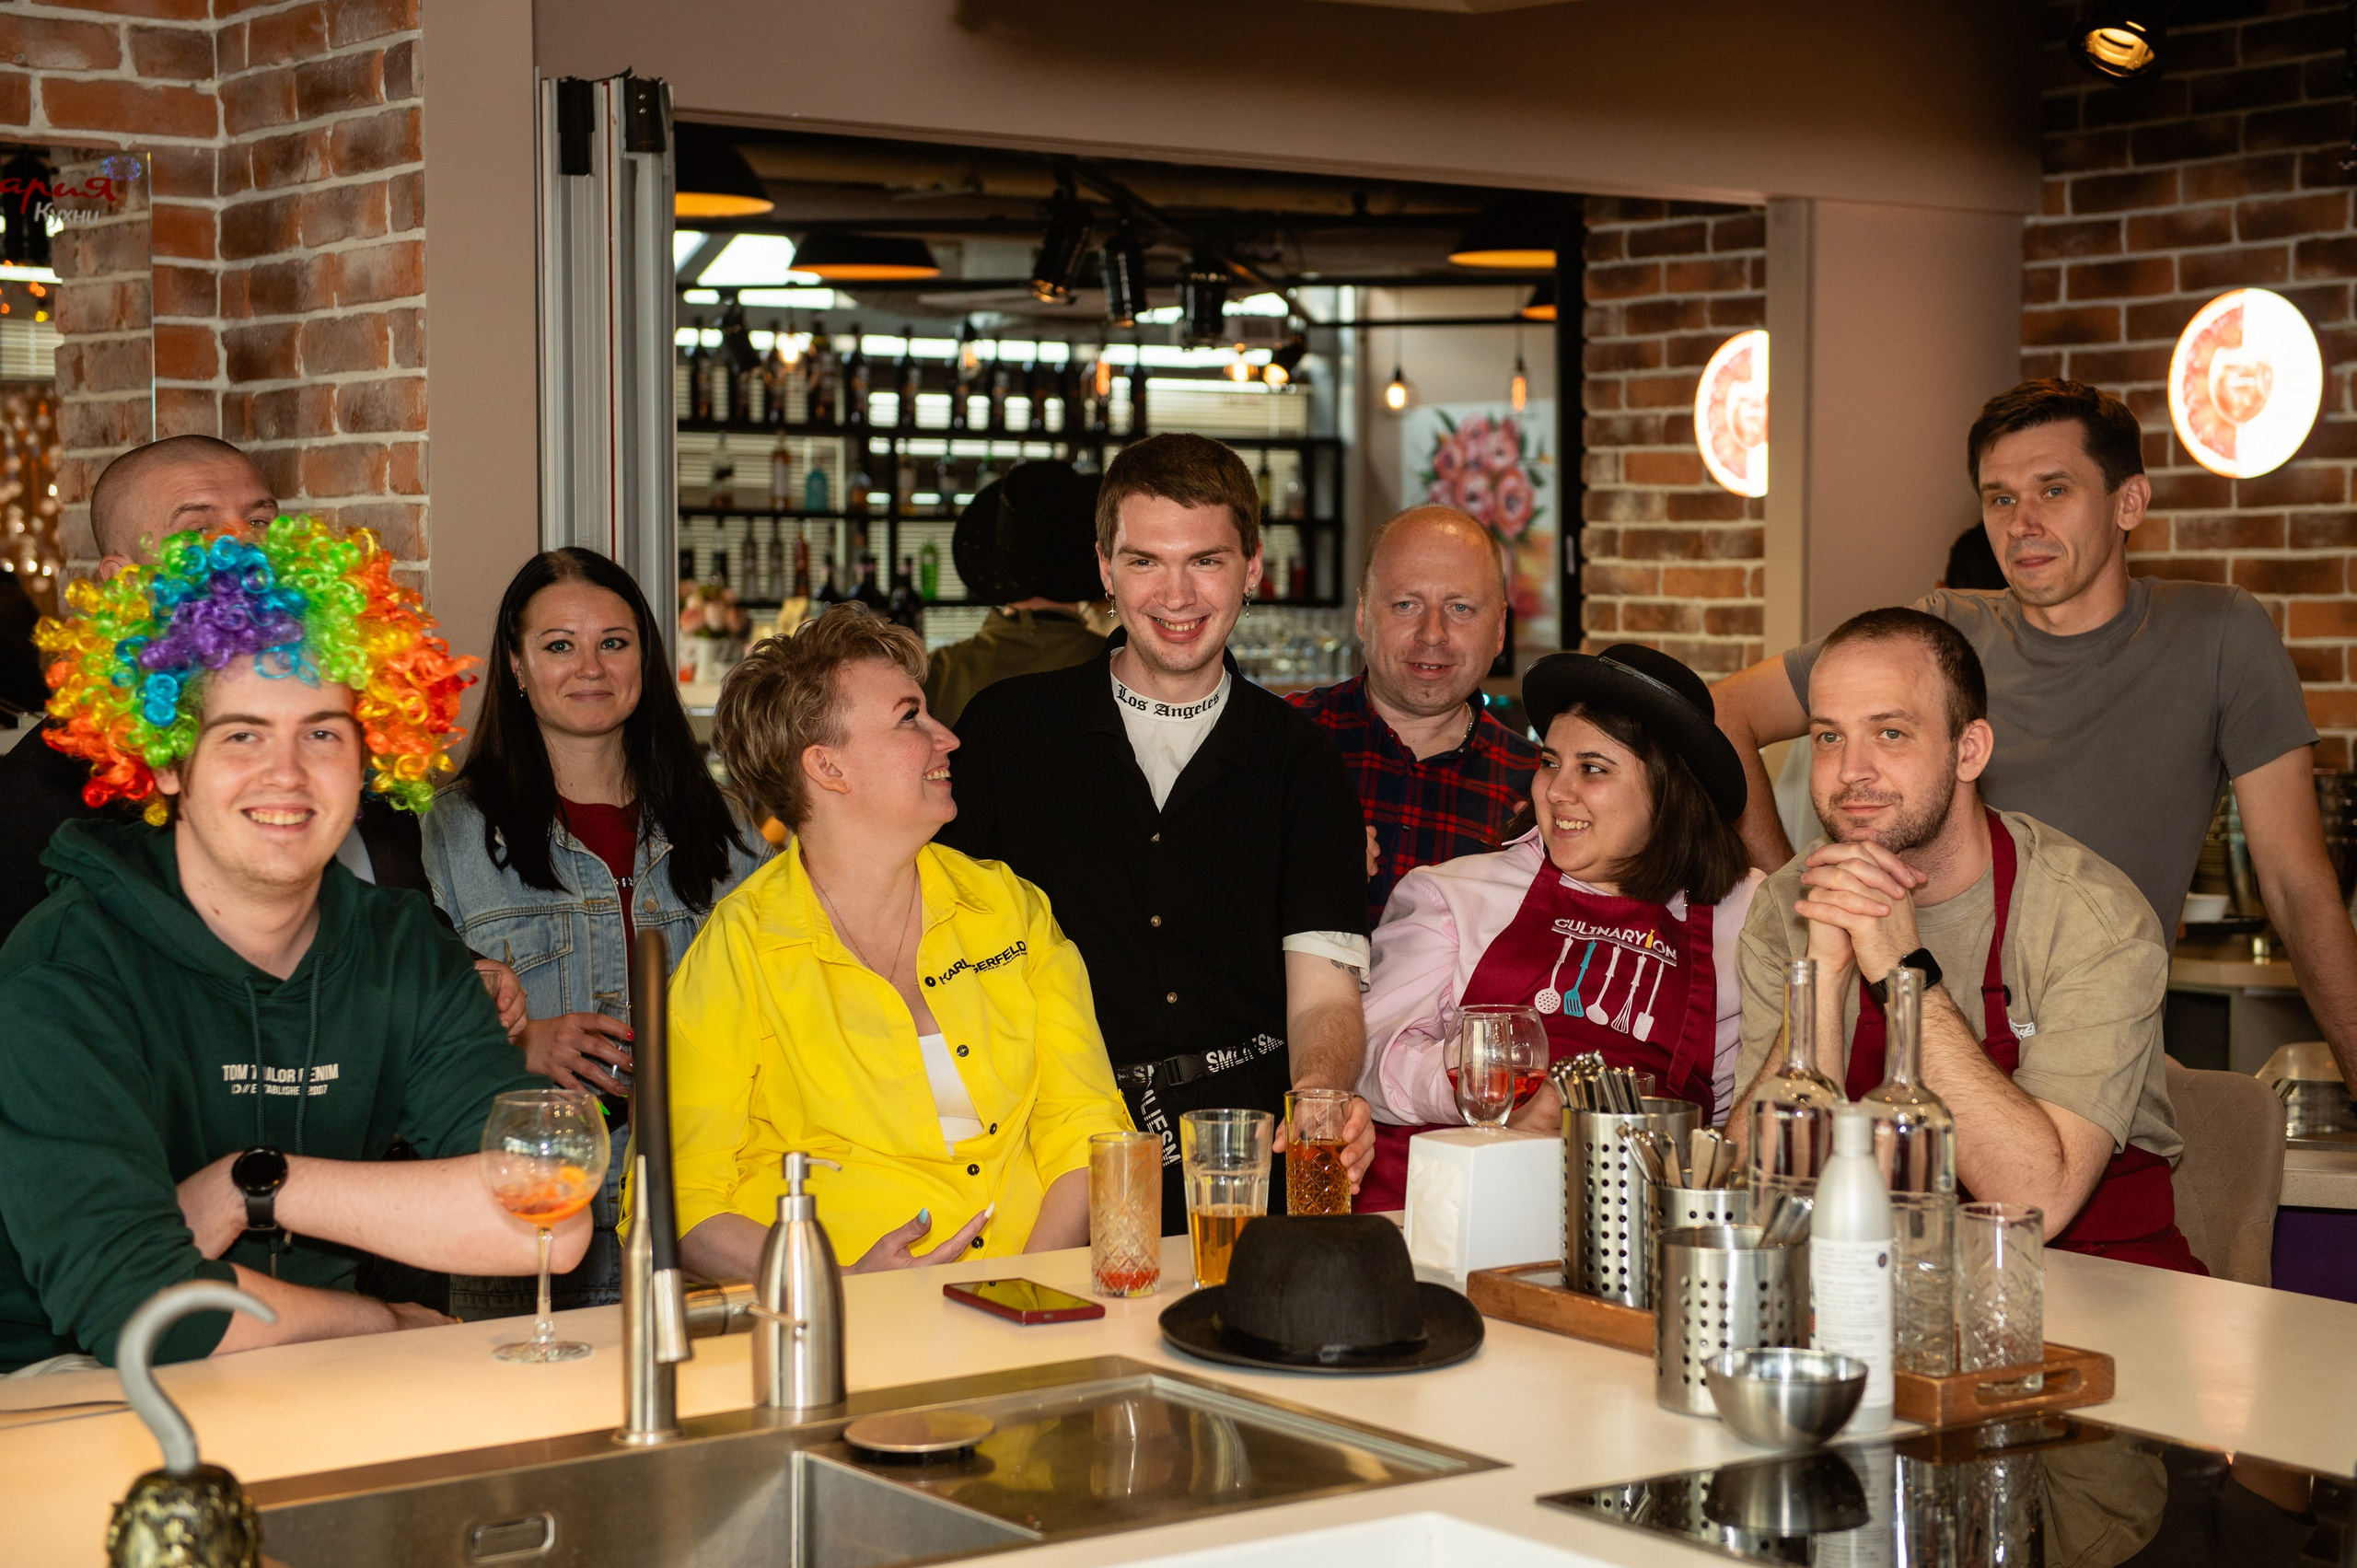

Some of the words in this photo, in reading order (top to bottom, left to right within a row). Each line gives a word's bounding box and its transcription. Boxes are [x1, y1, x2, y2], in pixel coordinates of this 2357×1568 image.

[34, 201, 99, 225] Кухни
[1116, 683, 1148, 712] Los
[1153, 691, 1220, 720] Angeles
[938, 958, 972, 985] KARL
[222, 1063, 249, 1081] TOM
[308, 1084, 329, 1096] 2007
